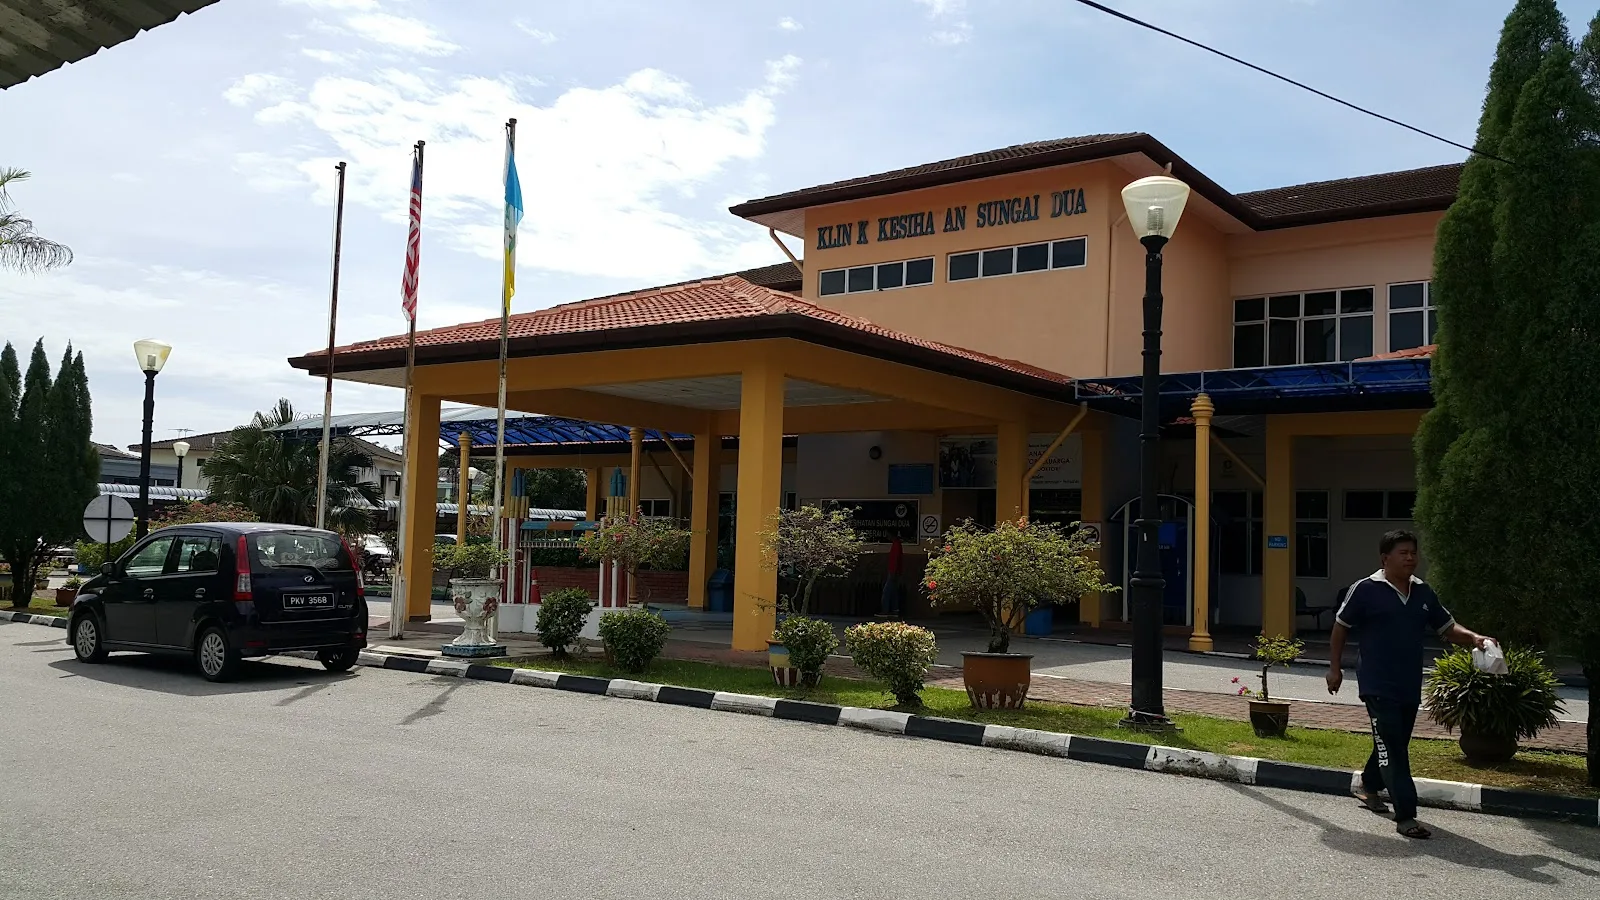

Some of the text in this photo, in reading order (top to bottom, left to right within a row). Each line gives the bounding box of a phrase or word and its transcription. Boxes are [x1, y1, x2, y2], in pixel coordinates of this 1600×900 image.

[976, 195, 1040, 228] SUNGAI
[1050, 188, 1087, 218] DUA
[290, 596, 327, 605] PKV 3568
